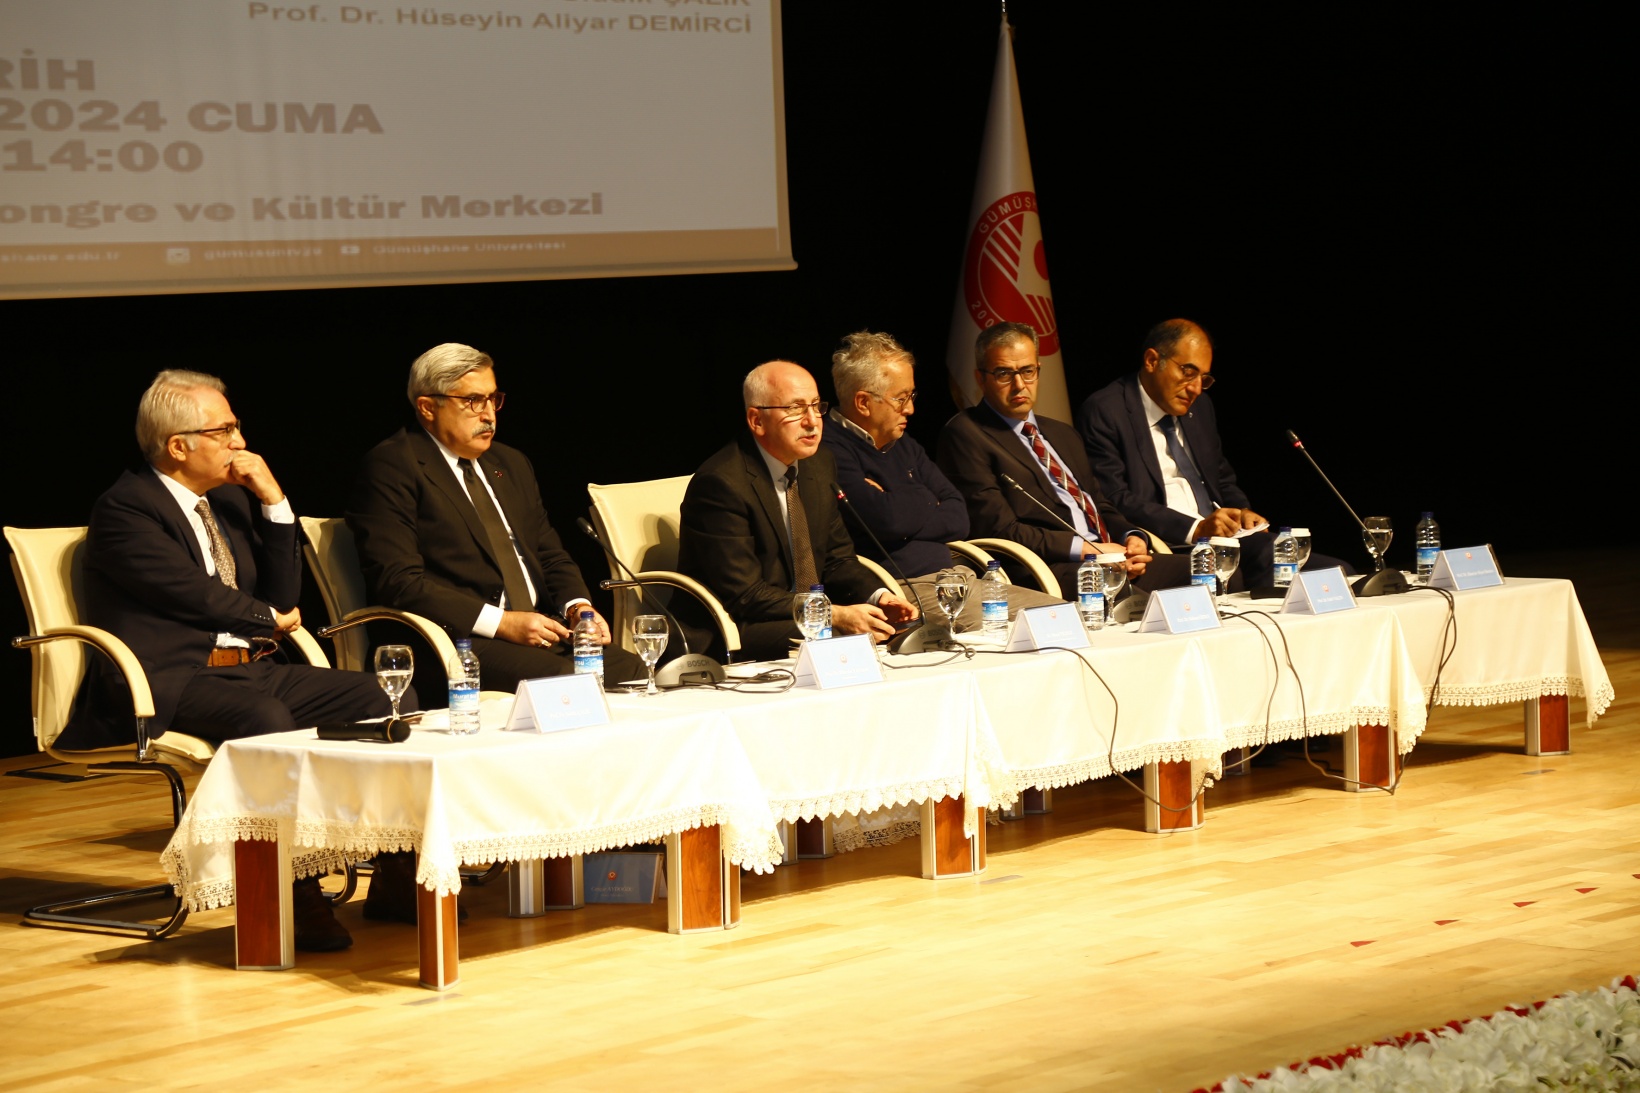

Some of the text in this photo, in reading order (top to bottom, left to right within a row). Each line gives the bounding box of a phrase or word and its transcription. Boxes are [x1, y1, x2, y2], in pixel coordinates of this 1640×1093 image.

[249, 2, 751, 34] Prof. Dr. Hüseyin Aliyar DEMİRCİ
[0, 98, 384, 134] 2024 CUMA
[2, 139, 204, 172] 14:00
[175, 203, 236, 222] ve
[252, 195, 406, 221] Kültür
[421, 192, 604, 219] Merkezi
